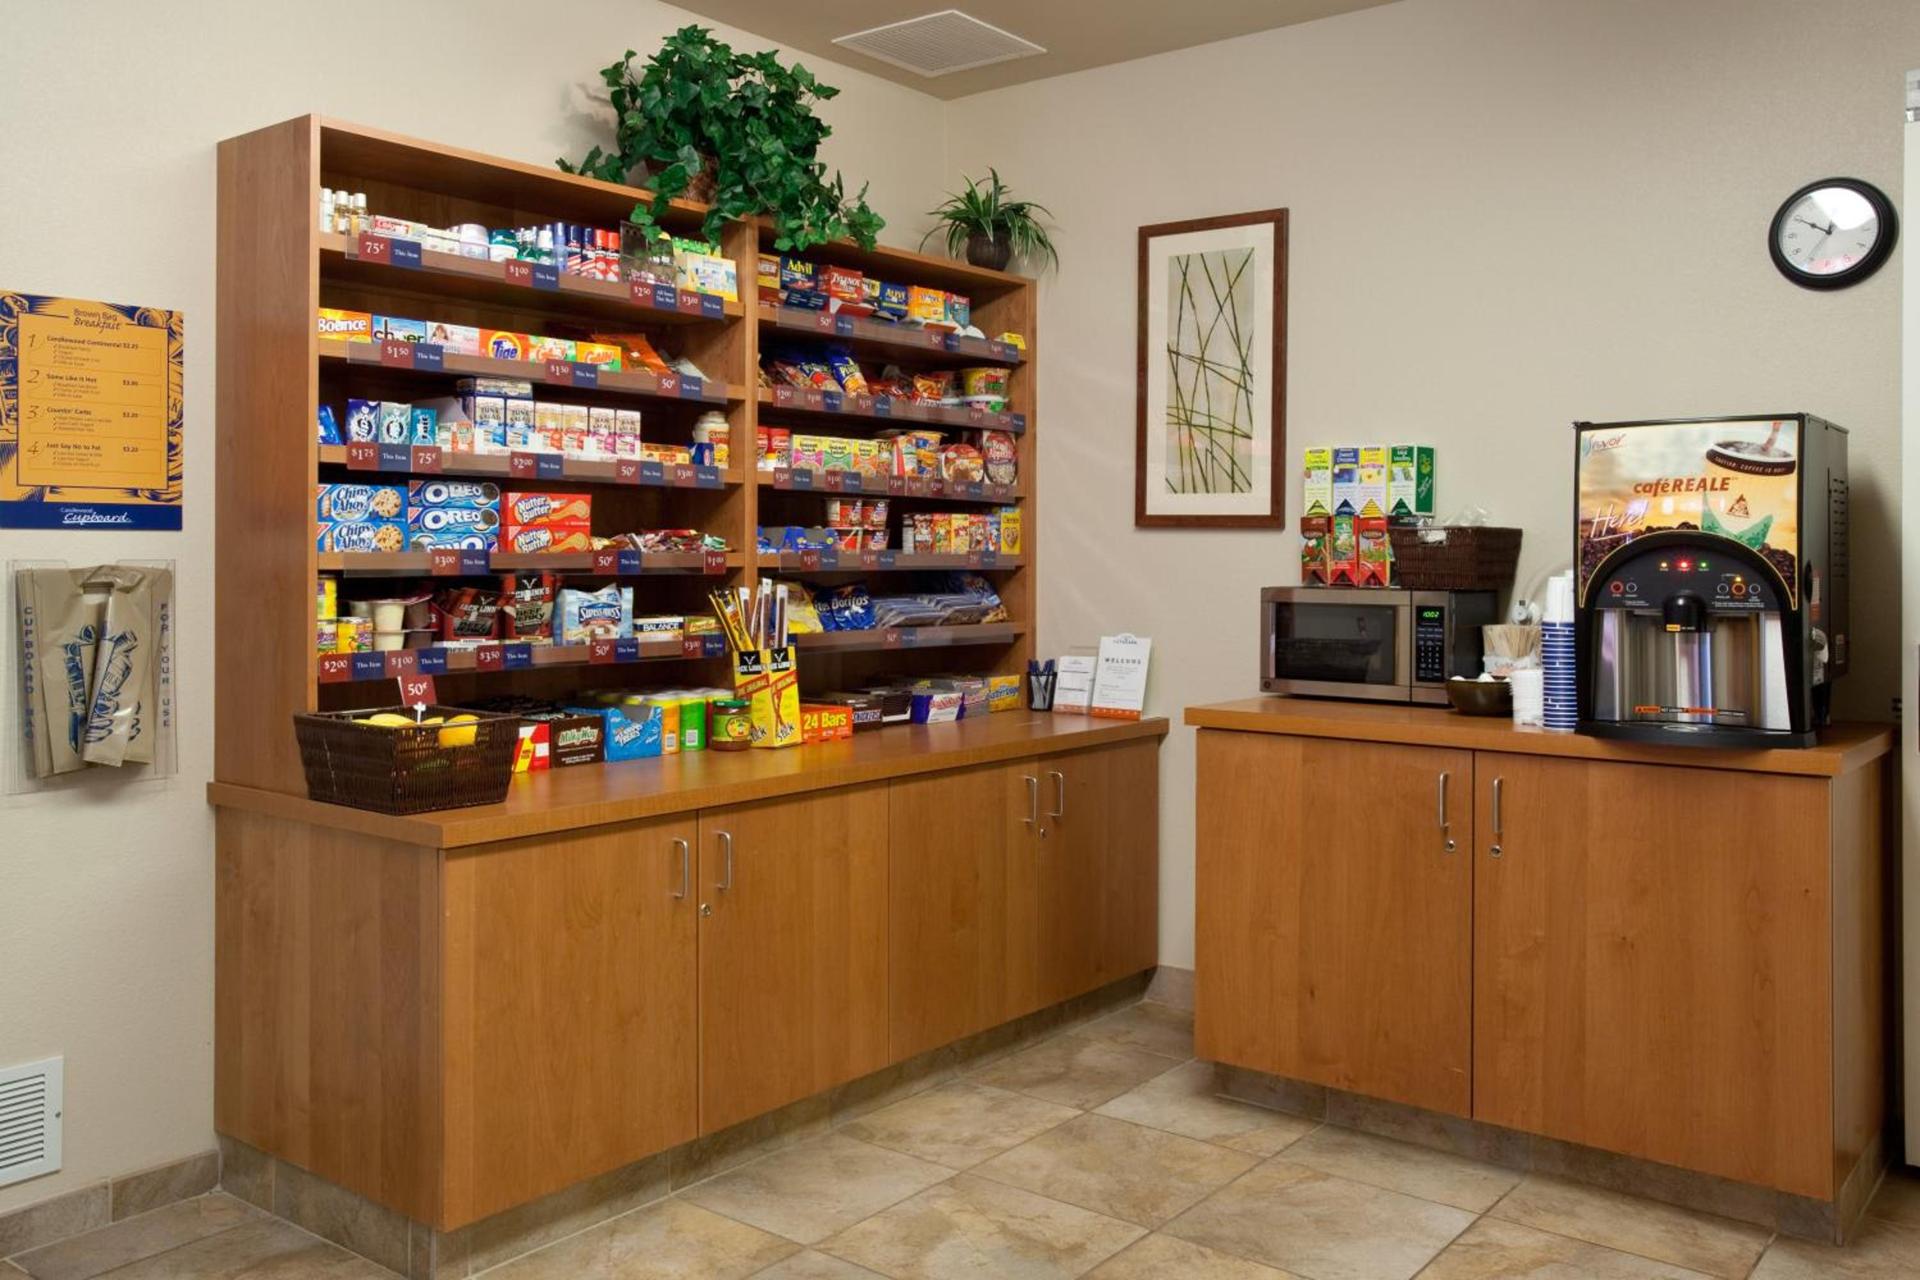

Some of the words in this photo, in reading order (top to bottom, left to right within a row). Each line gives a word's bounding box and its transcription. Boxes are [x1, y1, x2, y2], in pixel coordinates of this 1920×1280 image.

[365, 241, 385, 254] 75¢
[787, 259, 813, 275] Advil
[831, 272, 861, 286] TYLENOL
[74, 317, 121, 334] Breakfast
[319, 318, 367, 332] Bounce
[374, 318, 425, 342] cher
[387, 346, 409, 359] $150
[492, 340, 517, 360] Tide
[26, 369, 39, 384] 2
[27, 405, 39, 420] 3
[27, 440, 40, 455] 4
[352, 448, 374, 460] $175
[418, 452, 436, 464] 75¢
[336, 487, 369, 501] Chips
[424, 482, 482, 503] OREO
[1633, 476, 1731, 498] caféREALE
[422, 508, 481, 529] OREO
[522, 505, 551, 521] Butter
[1591, 501, 1648, 539] Here!
[339, 524, 371, 538] Chips
[598, 556, 614, 567] 50¢
[832, 595, 870, 609] Doritos
[160, 603, 168, 633] FOR
[642, 622, 680, 633] BALANCE
[480, 651, 500, 662] $350
[595, 644, 610, 657] 50¢
[324, 660, 348, 672] $200
[392, 657, 413, 669] $100
[408, 682, 428, 696] 50¢
[804, 714, 818, 730] 24
[821, 712, 847, 728] Bars
